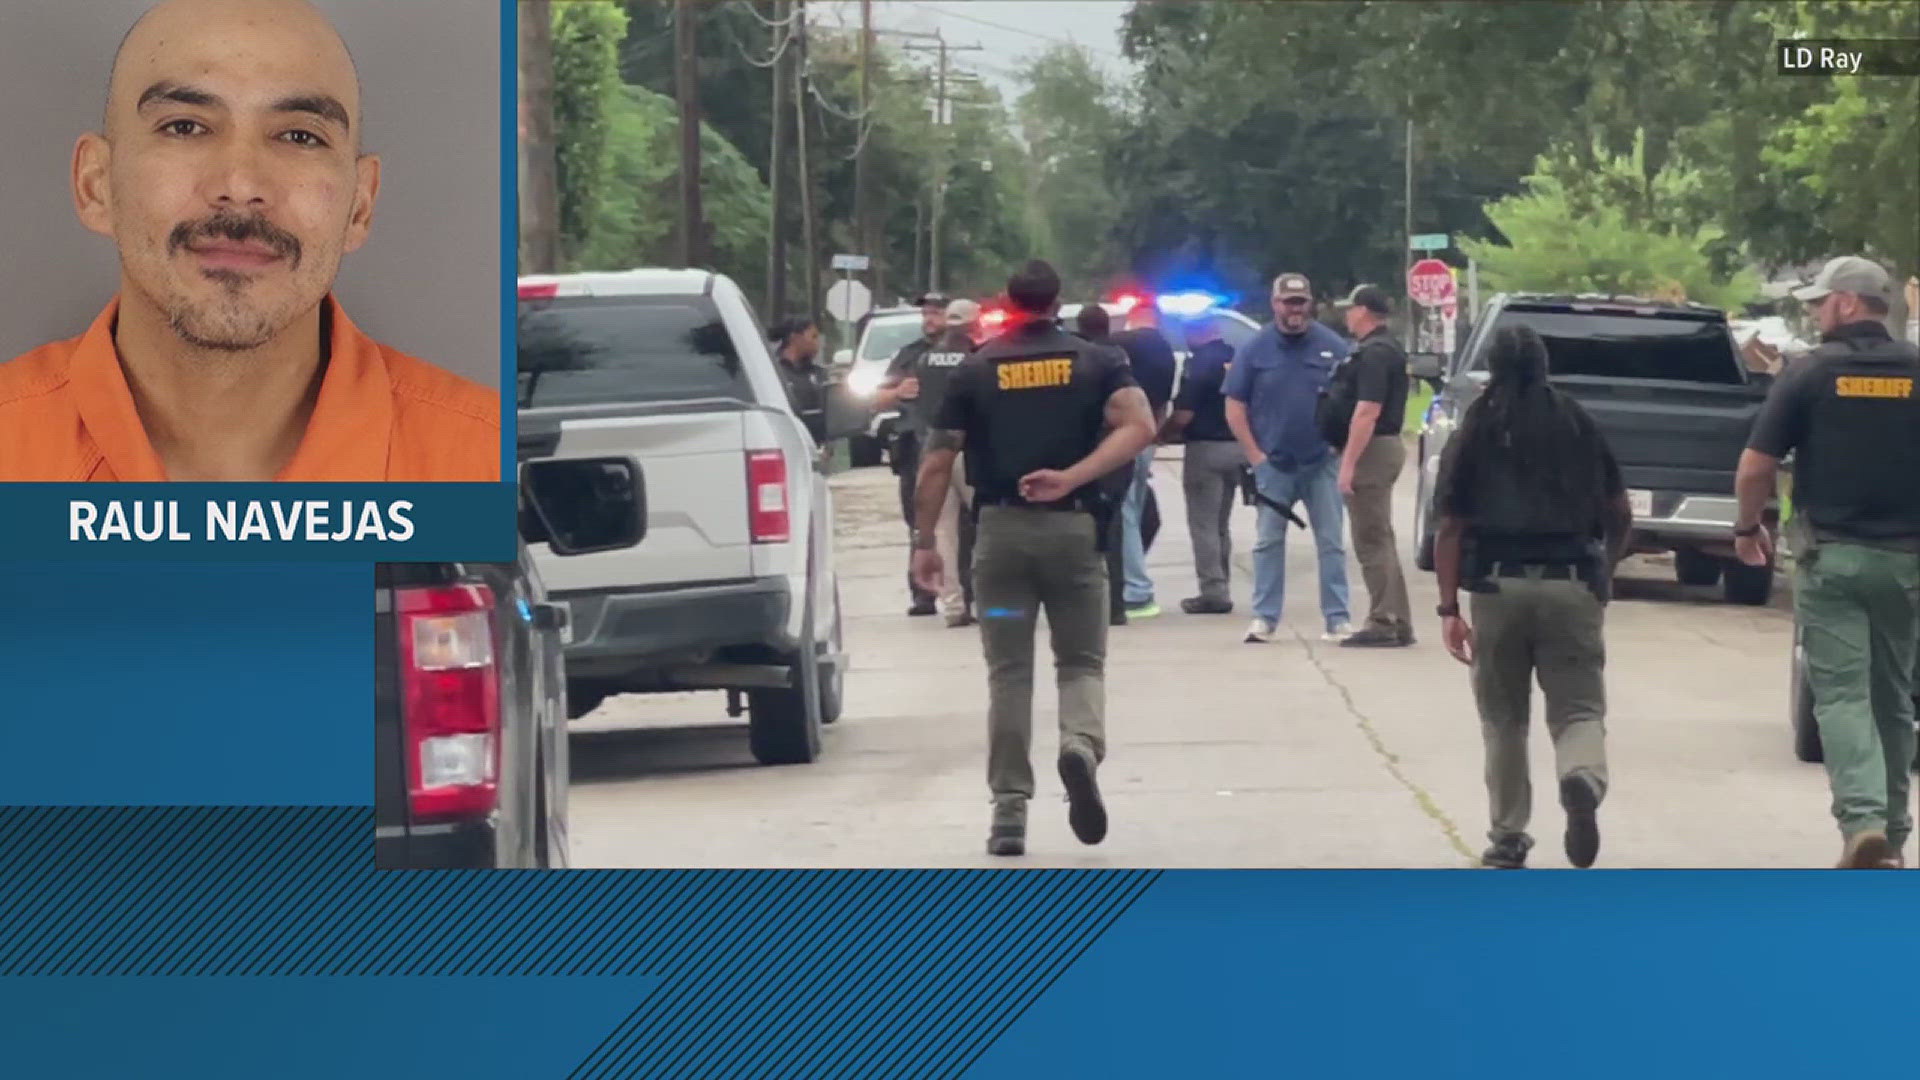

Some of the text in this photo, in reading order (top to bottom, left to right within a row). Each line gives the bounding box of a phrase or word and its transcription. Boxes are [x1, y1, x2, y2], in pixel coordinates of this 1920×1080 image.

[1411, 274, 1451, 297] STOP
[998, 359, 1072, 390] SHERIFF
[1836, 376, 1913, 398] SHERIFF
